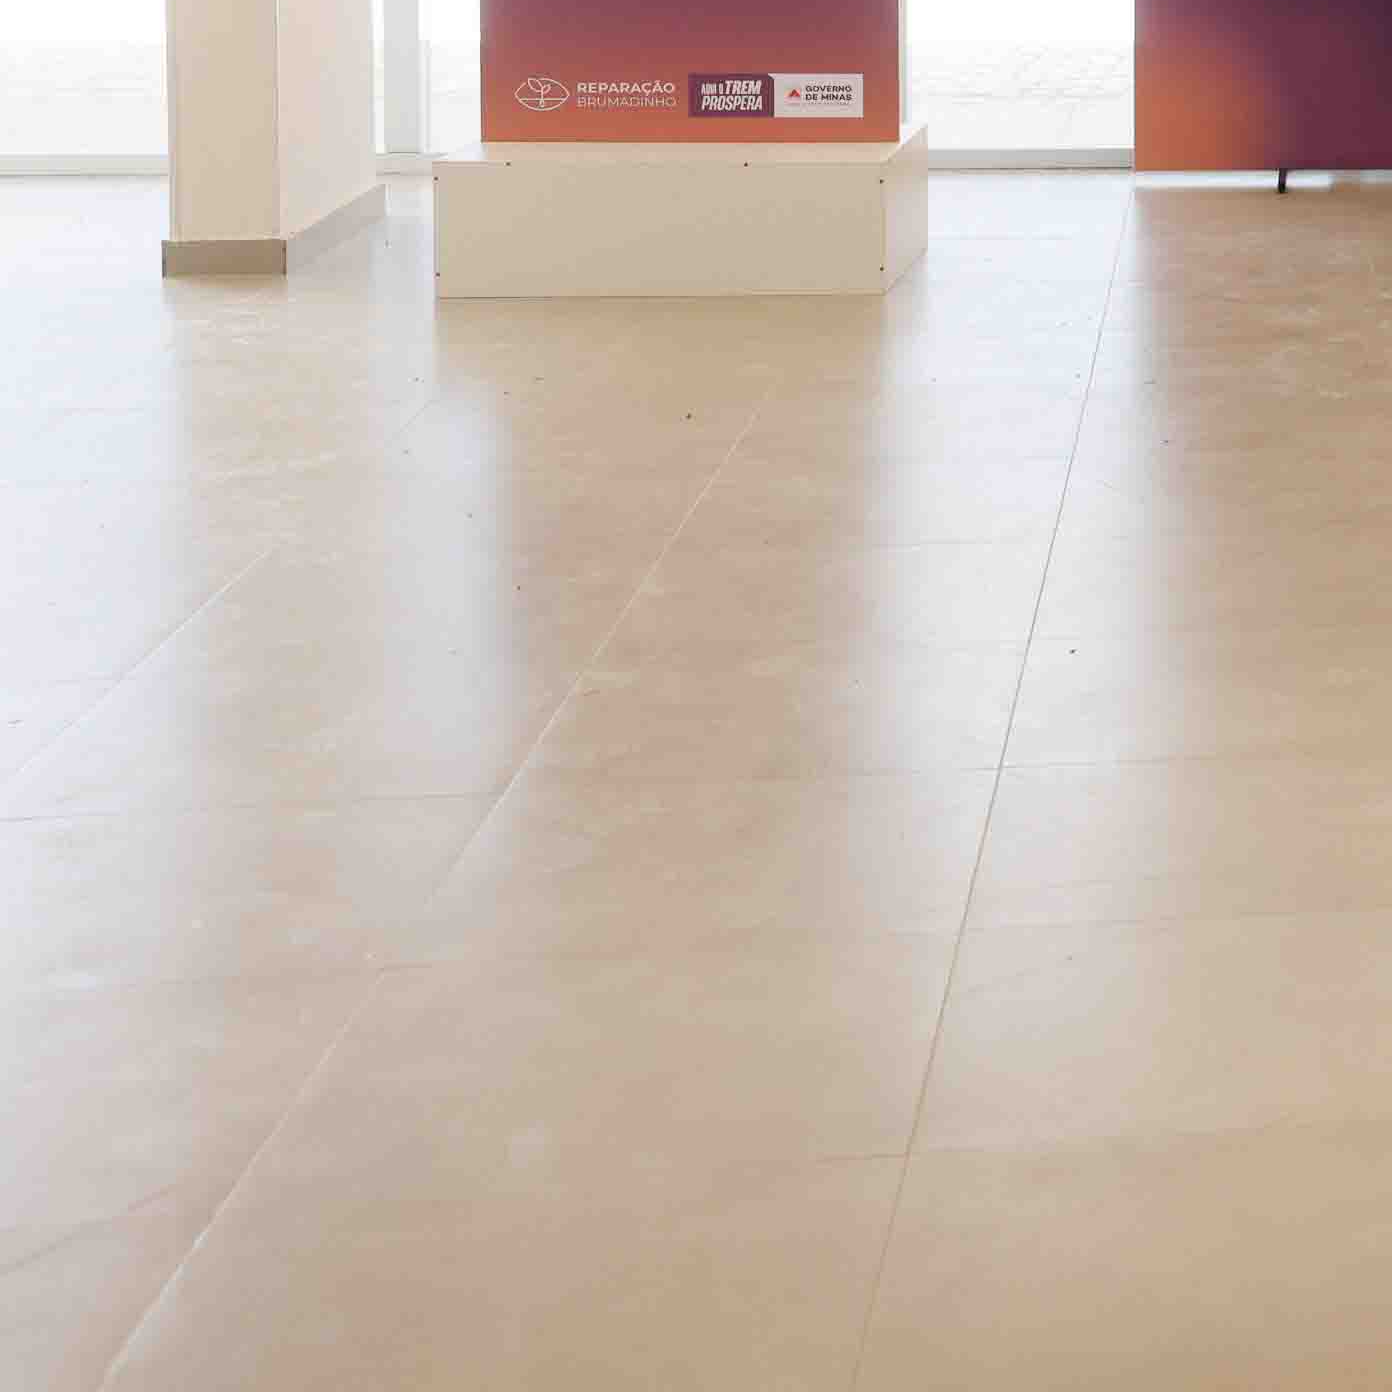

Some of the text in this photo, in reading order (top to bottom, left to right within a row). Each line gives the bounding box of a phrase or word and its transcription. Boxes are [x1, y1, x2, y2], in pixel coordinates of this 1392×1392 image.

[576, 79, 676, 96] REPARAÇÃO
[724, 80, 762, 95] TREM
[805, 85, 852, 93] GOVERNO
[577, 96, 677, 108] BRUMADINHO
[701, 95, 763, 111] PROSPERA
[805, 93, 853, 101] DE MINAS
